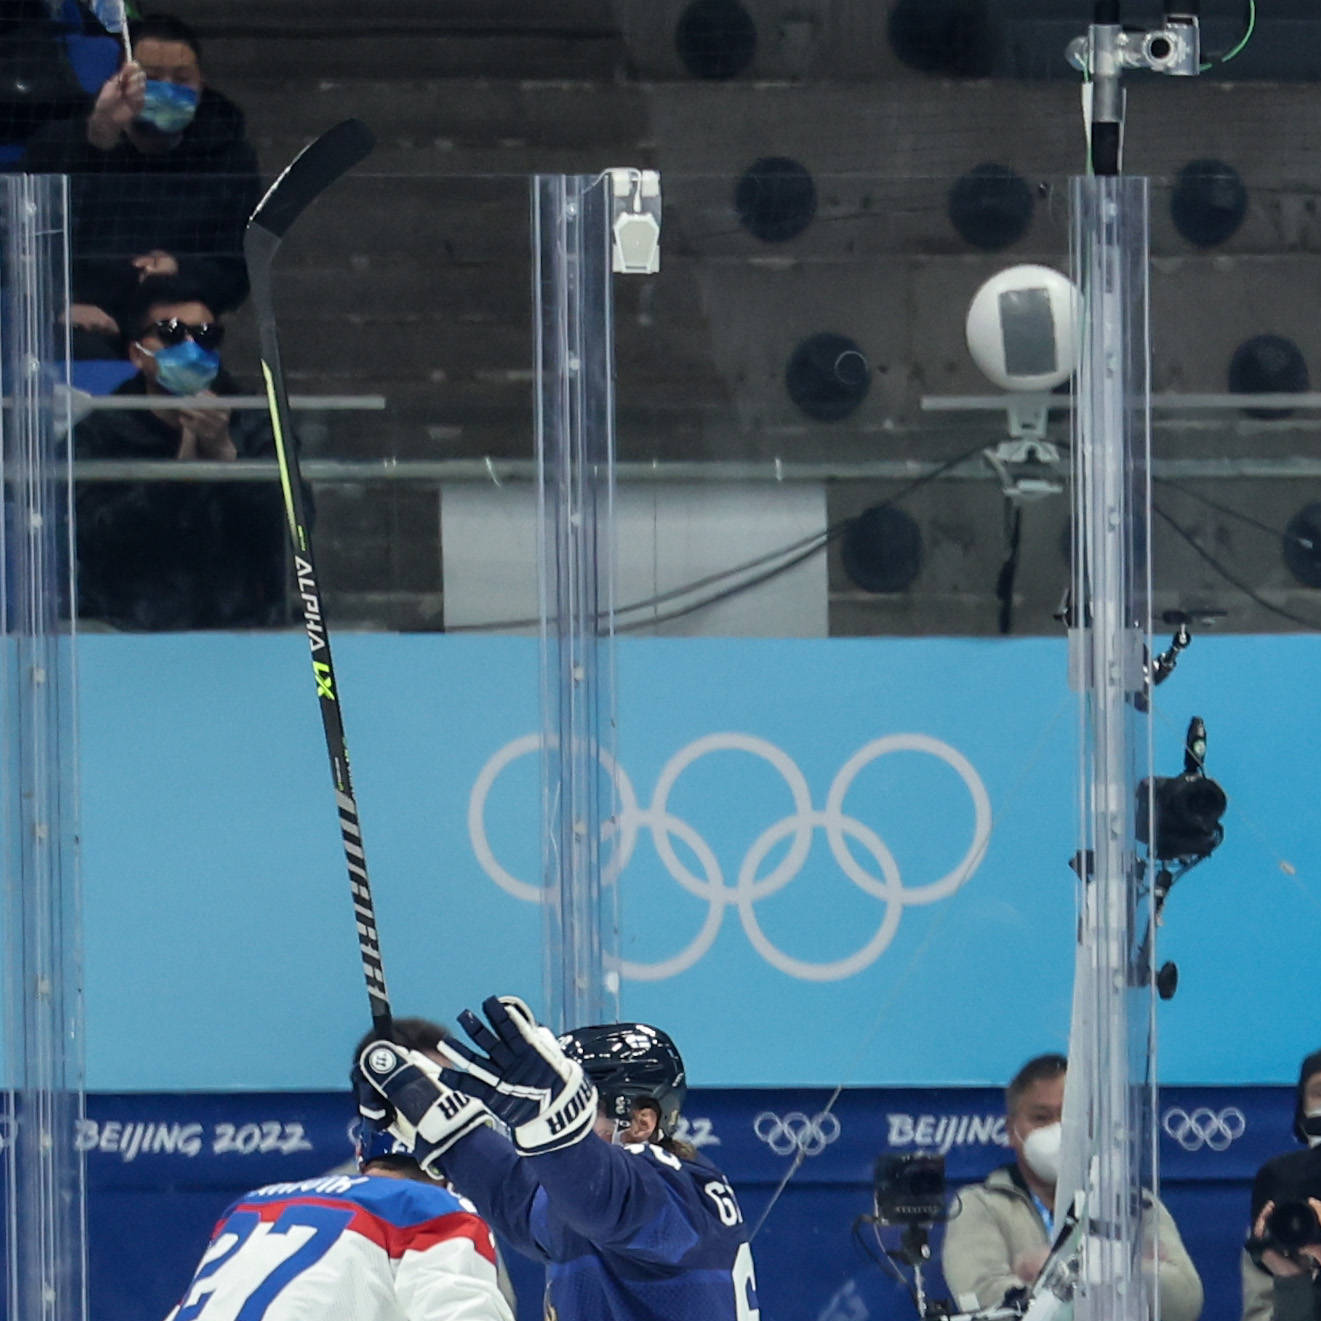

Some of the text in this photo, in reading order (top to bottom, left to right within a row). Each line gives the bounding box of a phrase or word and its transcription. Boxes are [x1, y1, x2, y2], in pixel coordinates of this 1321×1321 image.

[293, 555, 336, 701] ALPHA LX
[74, 1118, 313, 1163] BEIJING 2022
[885, 1112, 1010, 1156] BEIJING
